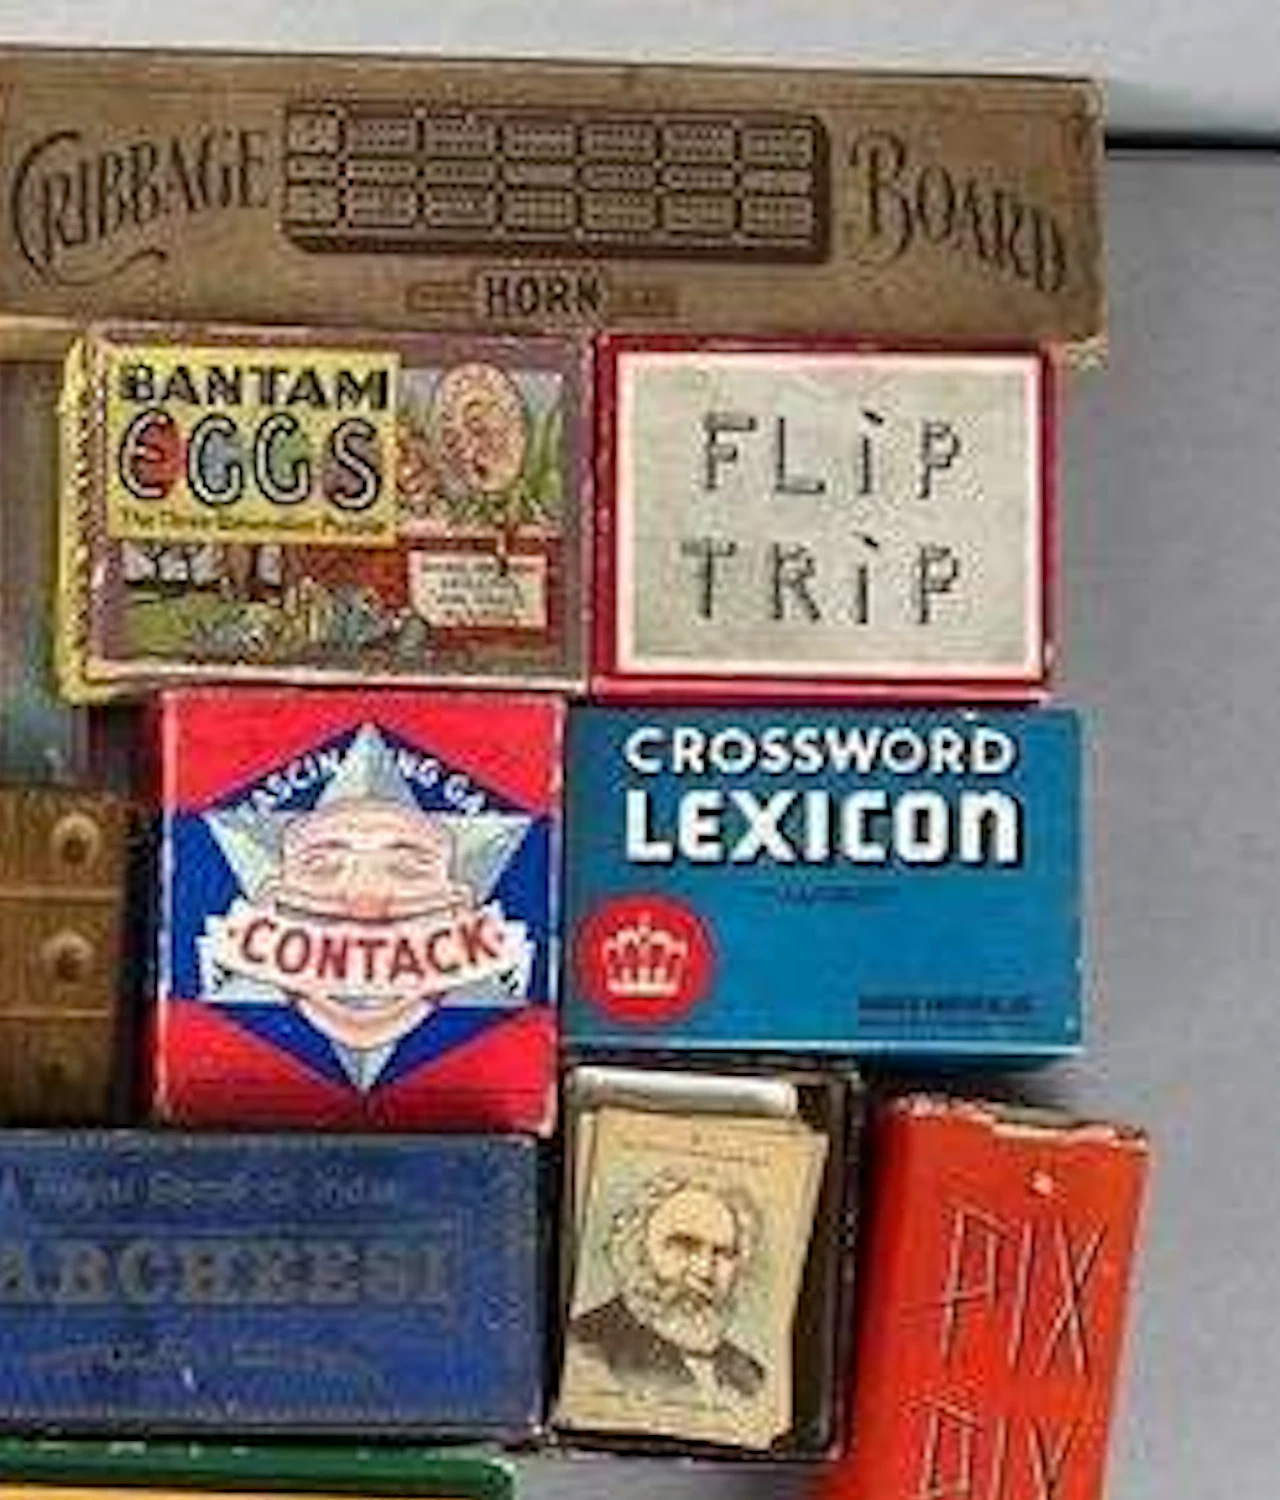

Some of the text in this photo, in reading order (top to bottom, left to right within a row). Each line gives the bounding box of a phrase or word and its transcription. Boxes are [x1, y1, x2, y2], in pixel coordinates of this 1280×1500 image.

[10, 130, 1068, 294] CRIBBAGE BOARD
[480, 273, 605, 318] HORN
[118, 363, 390, 412] BANTAM
[623, 727, 1018, 776] CROSSWORD
[242, 911, 500, 985] CONTACK
[936, 1206, 1109, 1378] PIX
